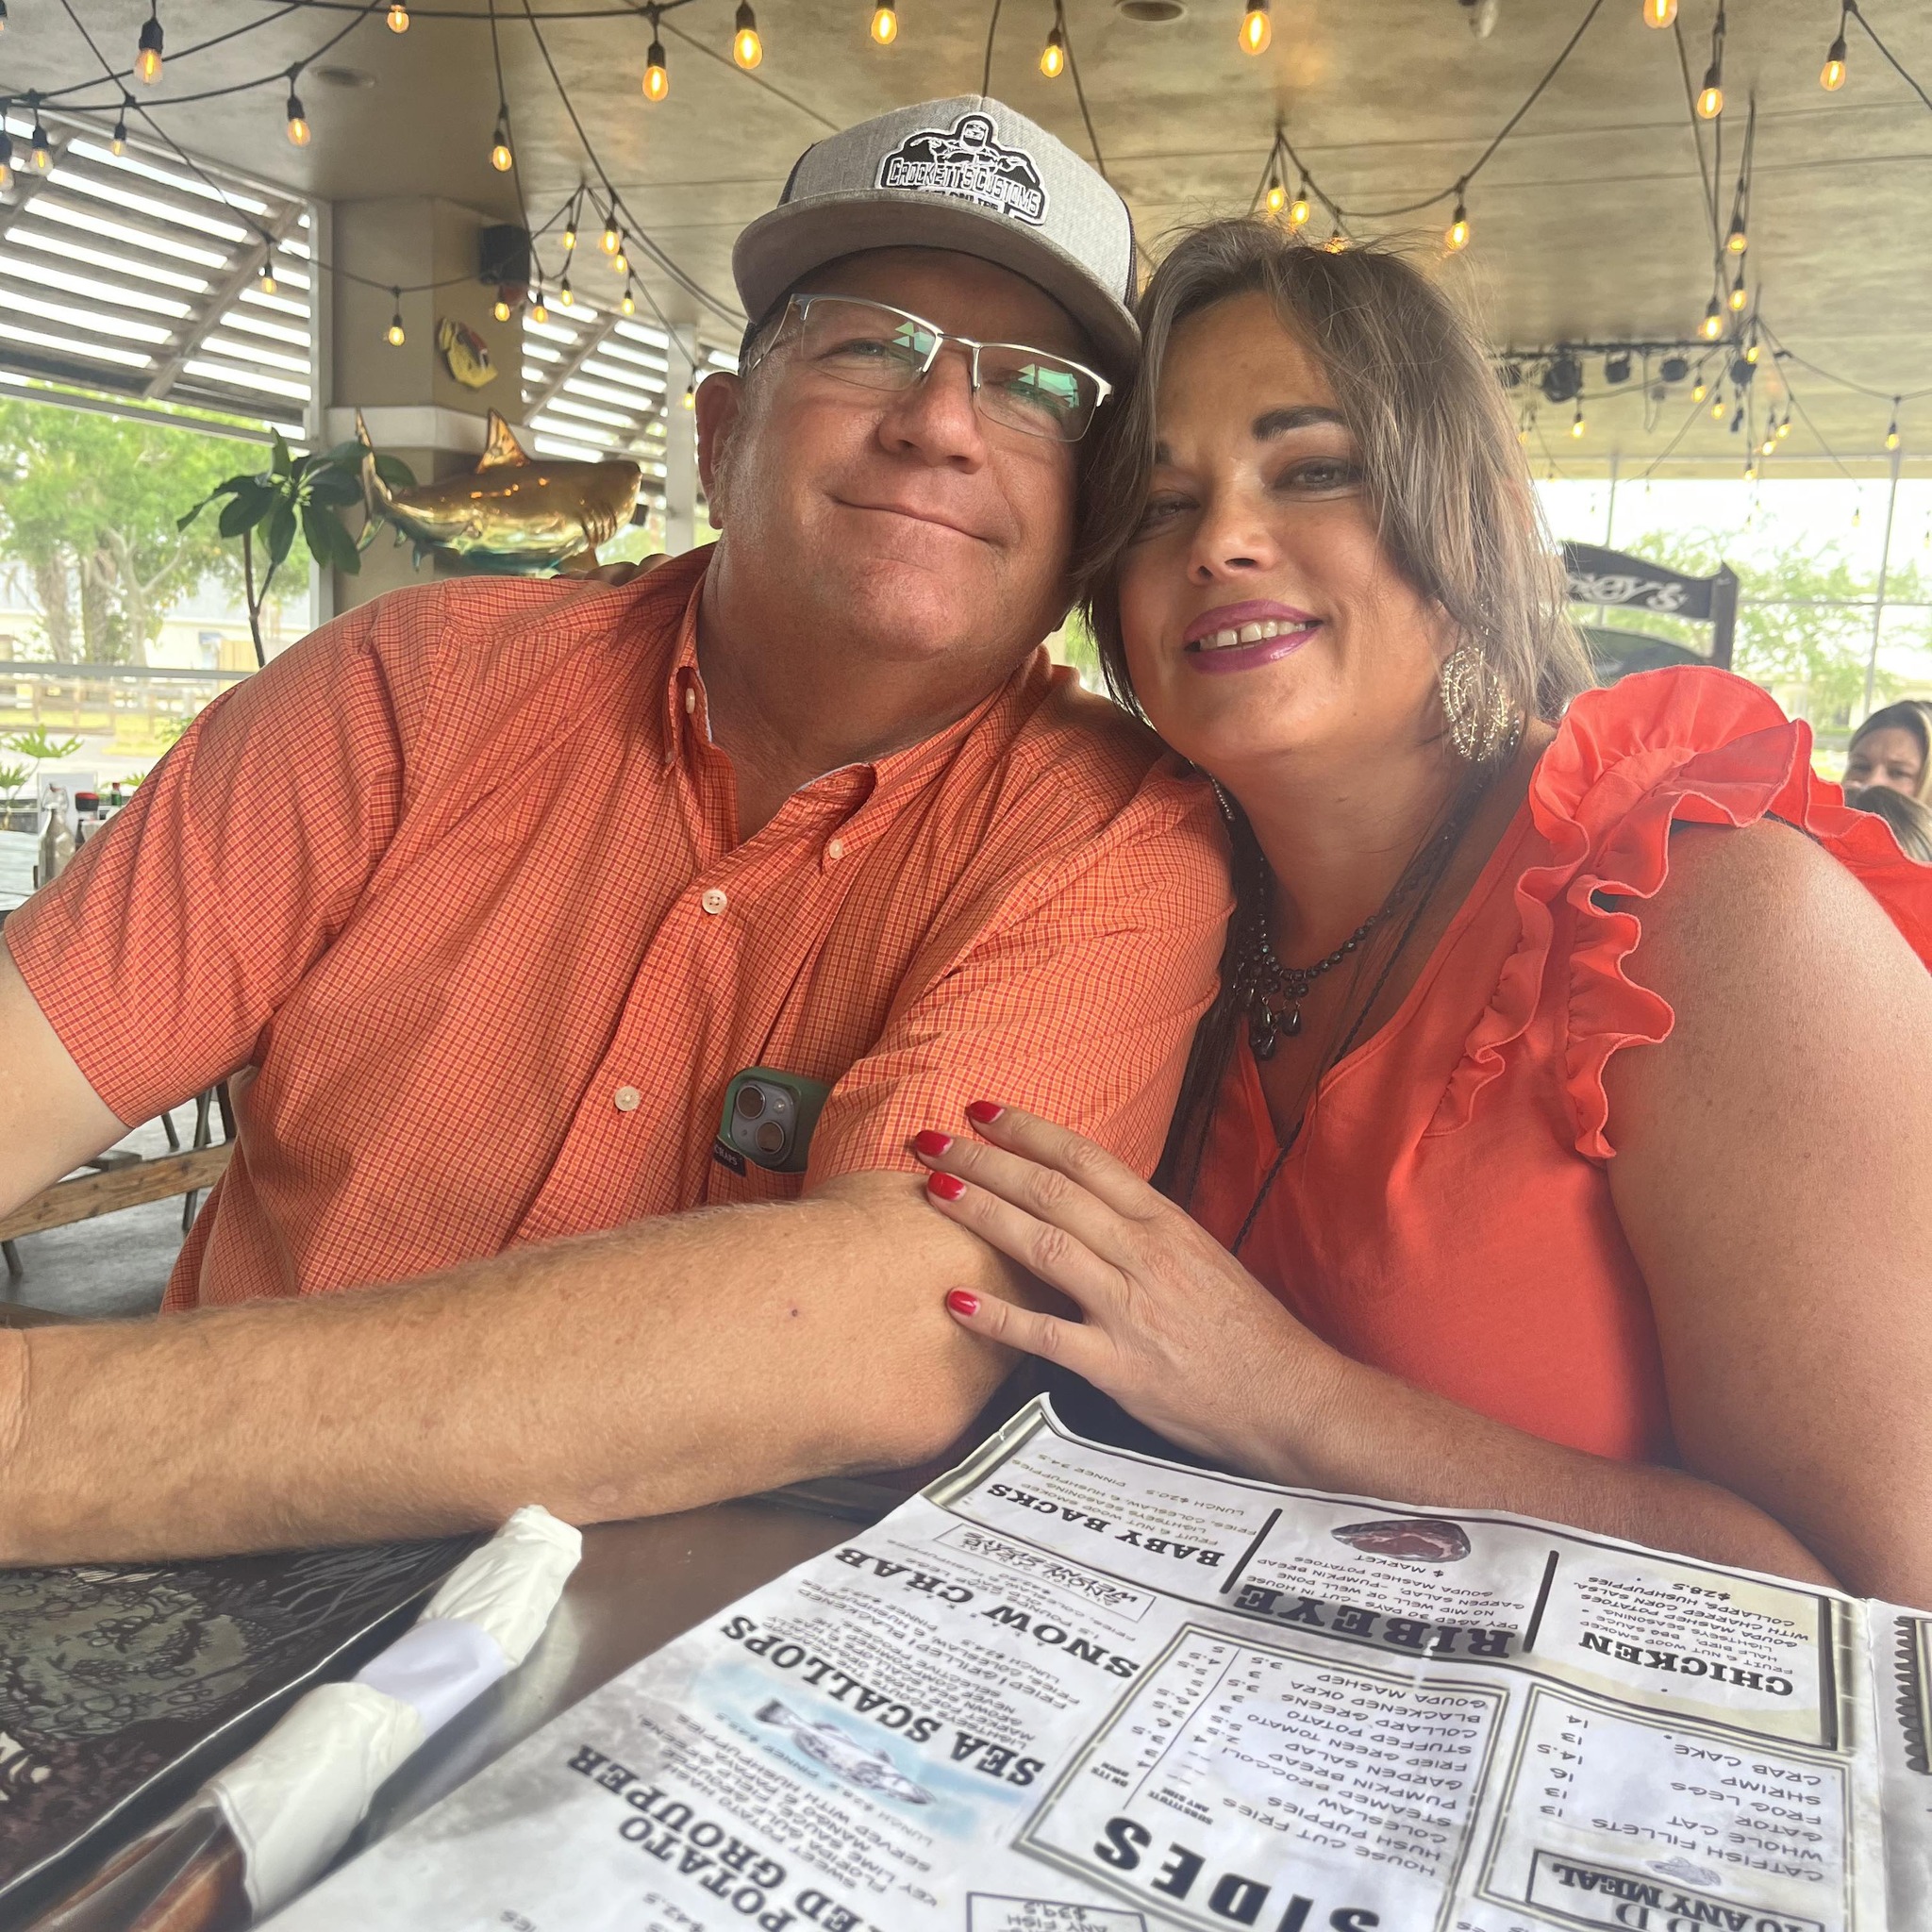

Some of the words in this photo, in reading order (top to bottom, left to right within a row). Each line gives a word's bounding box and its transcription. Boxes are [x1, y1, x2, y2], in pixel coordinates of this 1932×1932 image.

[1010, 1455, 1106, 1496] HUSHPUPPIES
[1074, 1468, 1125, 1487] DINNER
[1022, 1484, 1078, 1505] SMOKED
[1046, 1483, 1124, 1511] SEASONING
[1147, 1491, 1189, 1503] $20.5
[987, 1482, 1111, 1533] BACKS
[1082, 1506, 1122, 1520] WOOD
[1194, 1502, 1244, 1515] LUNCH
[1126, 1520, 1155, 1531] NUT
[1129, 1511, 1206, 1533] LIGHTSEYS
[1115, 1529, 1224, 1567] BABY
[1175, 1534, 1218, 1545] FRUIT
[1257, 1559, 1307, 1573] BREAD
[1294, 1557, 1365, 1574] POTATOES
[1355, 1556, 1425, 1573] MARKET
[833, 1548, 974, 1605] CRAB
[1247, 1575, 1295, 1591] HOUSE
[1277, 1573, 1315, 1585] DONE
[1372, 1573, 1435, 1589] MASHED
[1323, 1583, 1360, 1593] WELL
[1441, 1587, 1492, 1597] GOUDA
[1589, 1577, 1697, 1606] HUSHPUPPIES
[1672, 1583, 1731, 1602] $28.5
[1366, 1602, 1402, 1614] DAYS
[1394, 1598, 1433, 1609] WELL
[1459, 1600, 1524, 1609] GARDEN
[1581, 1594, 1658, 1615] POTATOES
[1634, 1598, 1677, 1610] CORN
[1233, 1584, 1515, 1658] RIBEYE
[1434, 1617, 1480, 1625] AGED
[1486, 1621, 1518, 1629] DRY
[1596, 1616, 1645, 1632] SAUCE
[1604, 1609, 1685, 1630] SEASONING
[1664, 1615, 1735, 1633] MASHED
[1683, 1610, 1762, 1629] CHARRED
[979, 1603, 1140, 1678] SNOW
[1580, 1622, 1639, 1641] SMOKED
[1651, 1630, 1679, 1640] BBQ
[1691, 1629, 1772, 1652] LIGHTSEYS
[1741, 1631, 1797, 1647] GOUDA
[1768, 1627, 1808, 1641] WITH
[1645, 1640, 1686, 1650] WOOD
[1691, 1648, 1721, 1657] NUT
[1578, 1631, 1793, 1696] CHICKEN
[1739, 1650, 1777, 1662] HALF
[1743, 1660, 1792, 1674] FRUIT
[720, 1615, 942, 1743] SCALLOPS
[1317, 1675, 1406, 1698] MASHED
[1291, 1681, 1344, 1700] OKRA
[1282, 1694, 1368, 1721] GREENS
[1351, 1699, 1480, 1723] BLACKENED
[1415, 1694, 1487, 1709] GOUDA
[1247, 1715, 1320, 1740] TOMATO
[1287, 1711, 1362, 1737] POTATO
[1375, 1720, 1477, 1738] COLLARD
[1566, 1715, 1589, 1728] 14
[1193, 1735, 1207, 1743] 4
[1371, 1735, 1471, 1754] STUFFED
[1560, 1732, 1582, 1745] 13
[949, 1731, 1044, 1788] SEA
[1285, 1744, 1358, 1768] SALAD
[1329, 1739, 1399, 1760] GREEN
[1537, 1743, 1583, 1765] 14.5
[1674, 1744, 1741, 1766] CAKE
[1222, 1747, 1329, 1791] BROCCOLI
[1269, 1755, 1344, 1781] BREAD
[1406, 1758, 1467, 1772] FRIED
[1550, 1767, 1574, 1782] 16
[1752, 1765, 1821, 1786] CRAB
[1367, 1765, 1462, 1790] GARDEN
[1354, 1778, 1457, 1809] PUMPKIN
[1544, 1788, 1567, 1799] 13
[1671, 1783, 1740, 1806] LEGS
[1721, 1777, 1821, 1805] SHRIMP
[565, 1742, 787, 1890] GROUPER
[1224, 1798, 1290, 1831] FRIES
[1268, 1797, 1367, 1839] PUPPIES
[1338, 1791, 1451, 1827] STEAMED
[1540, 1806, 1563, 1818] 13
[1750, 1803, 1821, 1824] FROG
[1318, 1798, 1447, 1843] COLESLAW
[1667, 1816, 1719, 1835] CAT
[1735, 1816, 1823, 1841] GATOR
[1296, 1830, 1346, 1848] CUT
[1592, 1819, 1696, 1850] FILLETS
[1376, 1836, 1441, 1861] HUSH
[1728, 1832, 1823, 1862] WHOLE
[1355, 1845, 1435, 1876] HOUSE
[1707, 1846, 1824, 1881] CATFISH
[617, 1815, 797, 1932] POTATO
[1553, 1863, 1662, 1909] MEAL
[1664, 1893, 1752, 1932] ANY
